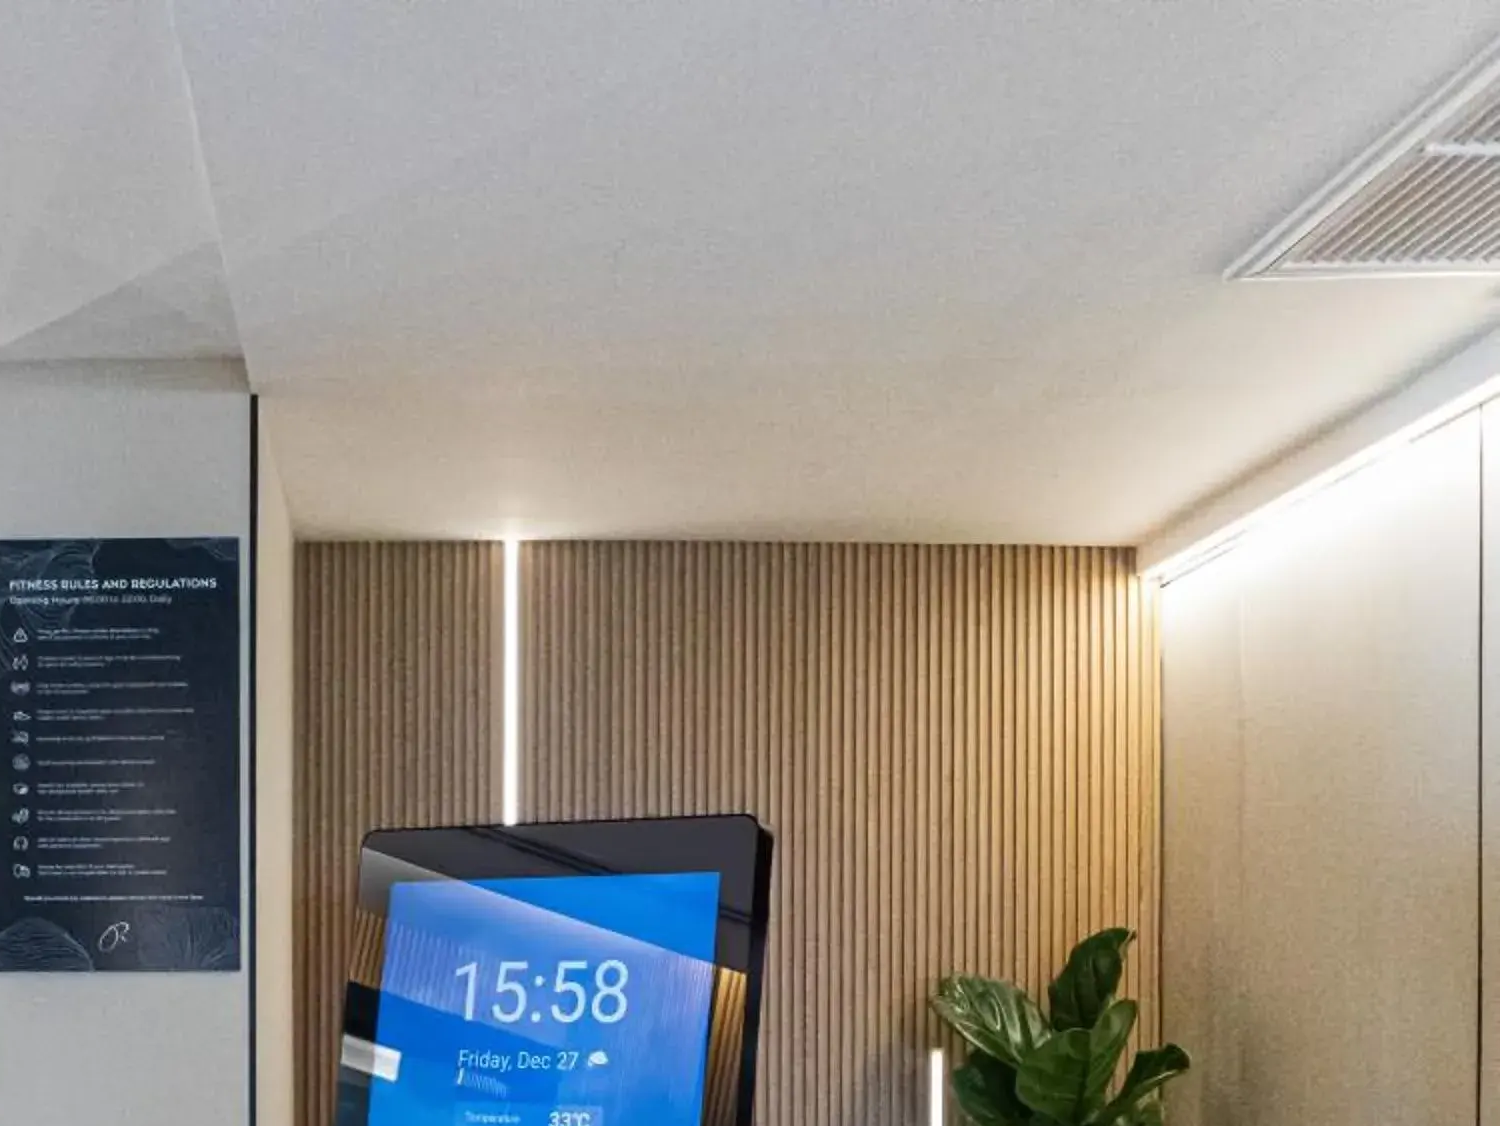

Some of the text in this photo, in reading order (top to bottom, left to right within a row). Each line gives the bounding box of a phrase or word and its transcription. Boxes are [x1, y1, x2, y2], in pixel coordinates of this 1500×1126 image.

[9, 577, 217, 591] FITNESS RULES AND REGULATIONS
[455, 960, 629, 1024] 15:58
[457, 1049, 580, 1072] Friday, Dec 27
